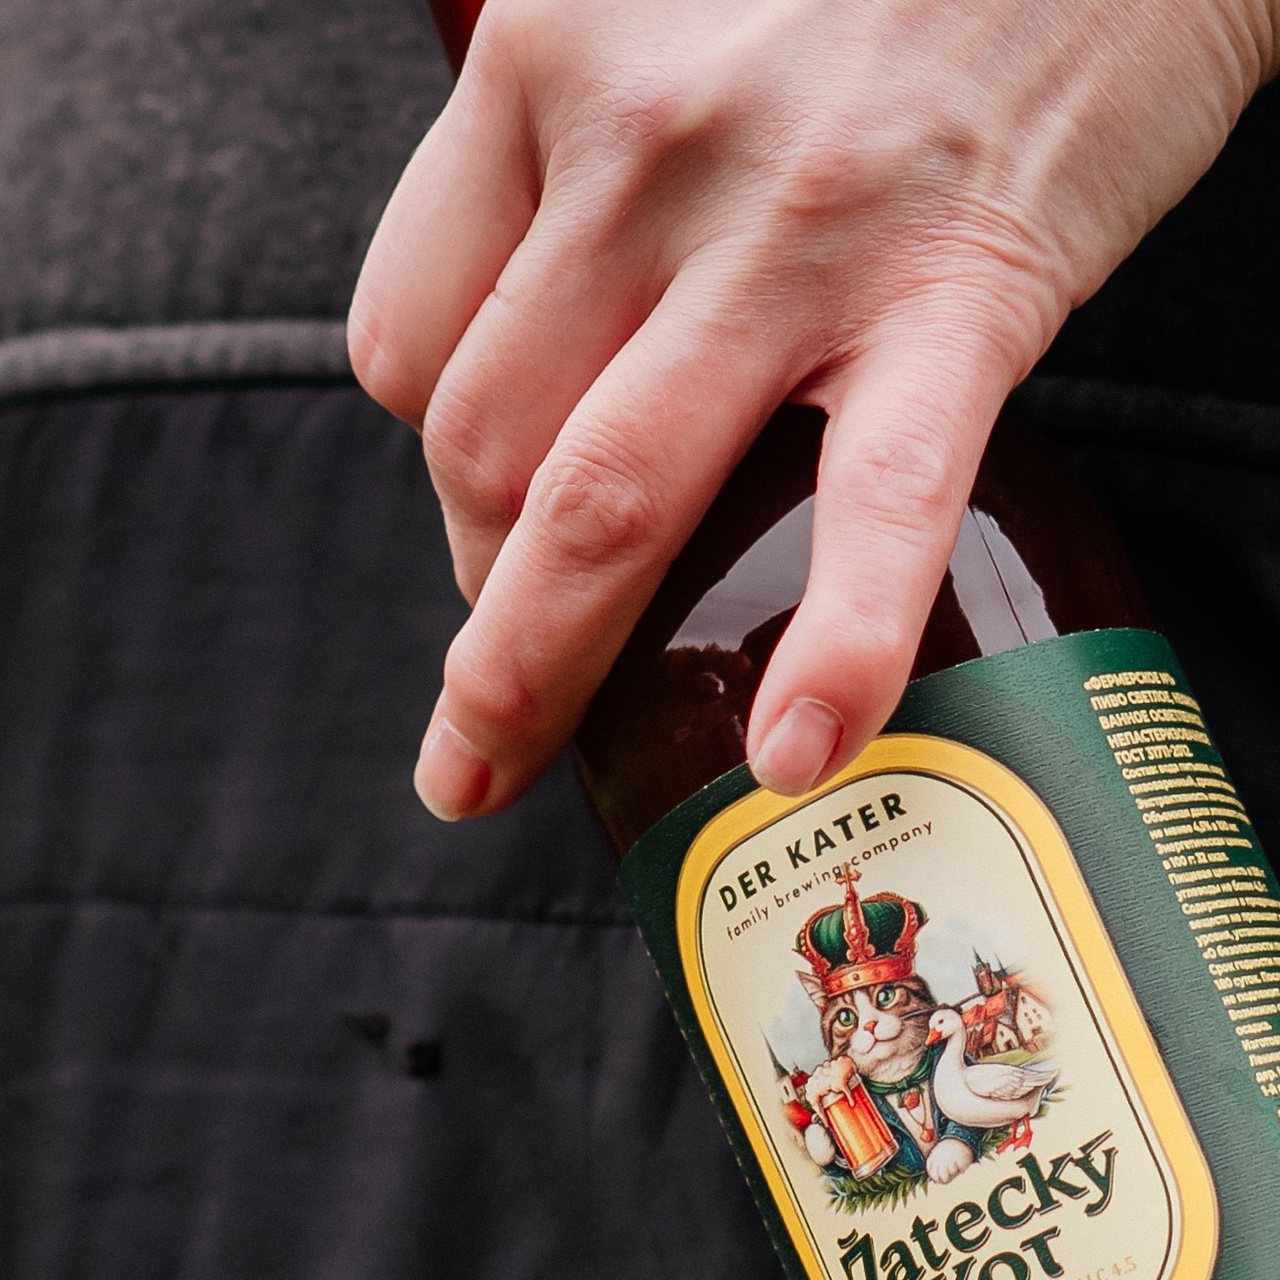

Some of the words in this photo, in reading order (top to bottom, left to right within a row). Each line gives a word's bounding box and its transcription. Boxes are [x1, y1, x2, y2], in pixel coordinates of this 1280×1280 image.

[1090, 692, 1128, 710] ПИВО
[1098, 709, 1150, 730] ВАННОЕ
[1114, 748, 1146, 765] ГОСТ
[718, 860, 777, 912] DER
[785, 792, 907, 869] KATER
[727, 906, 770, 940] family
[773, 866, 845, 908] brewing
[851, 821, 933, 866] company
[1110, 1255, 1138, 1278] 4.5
